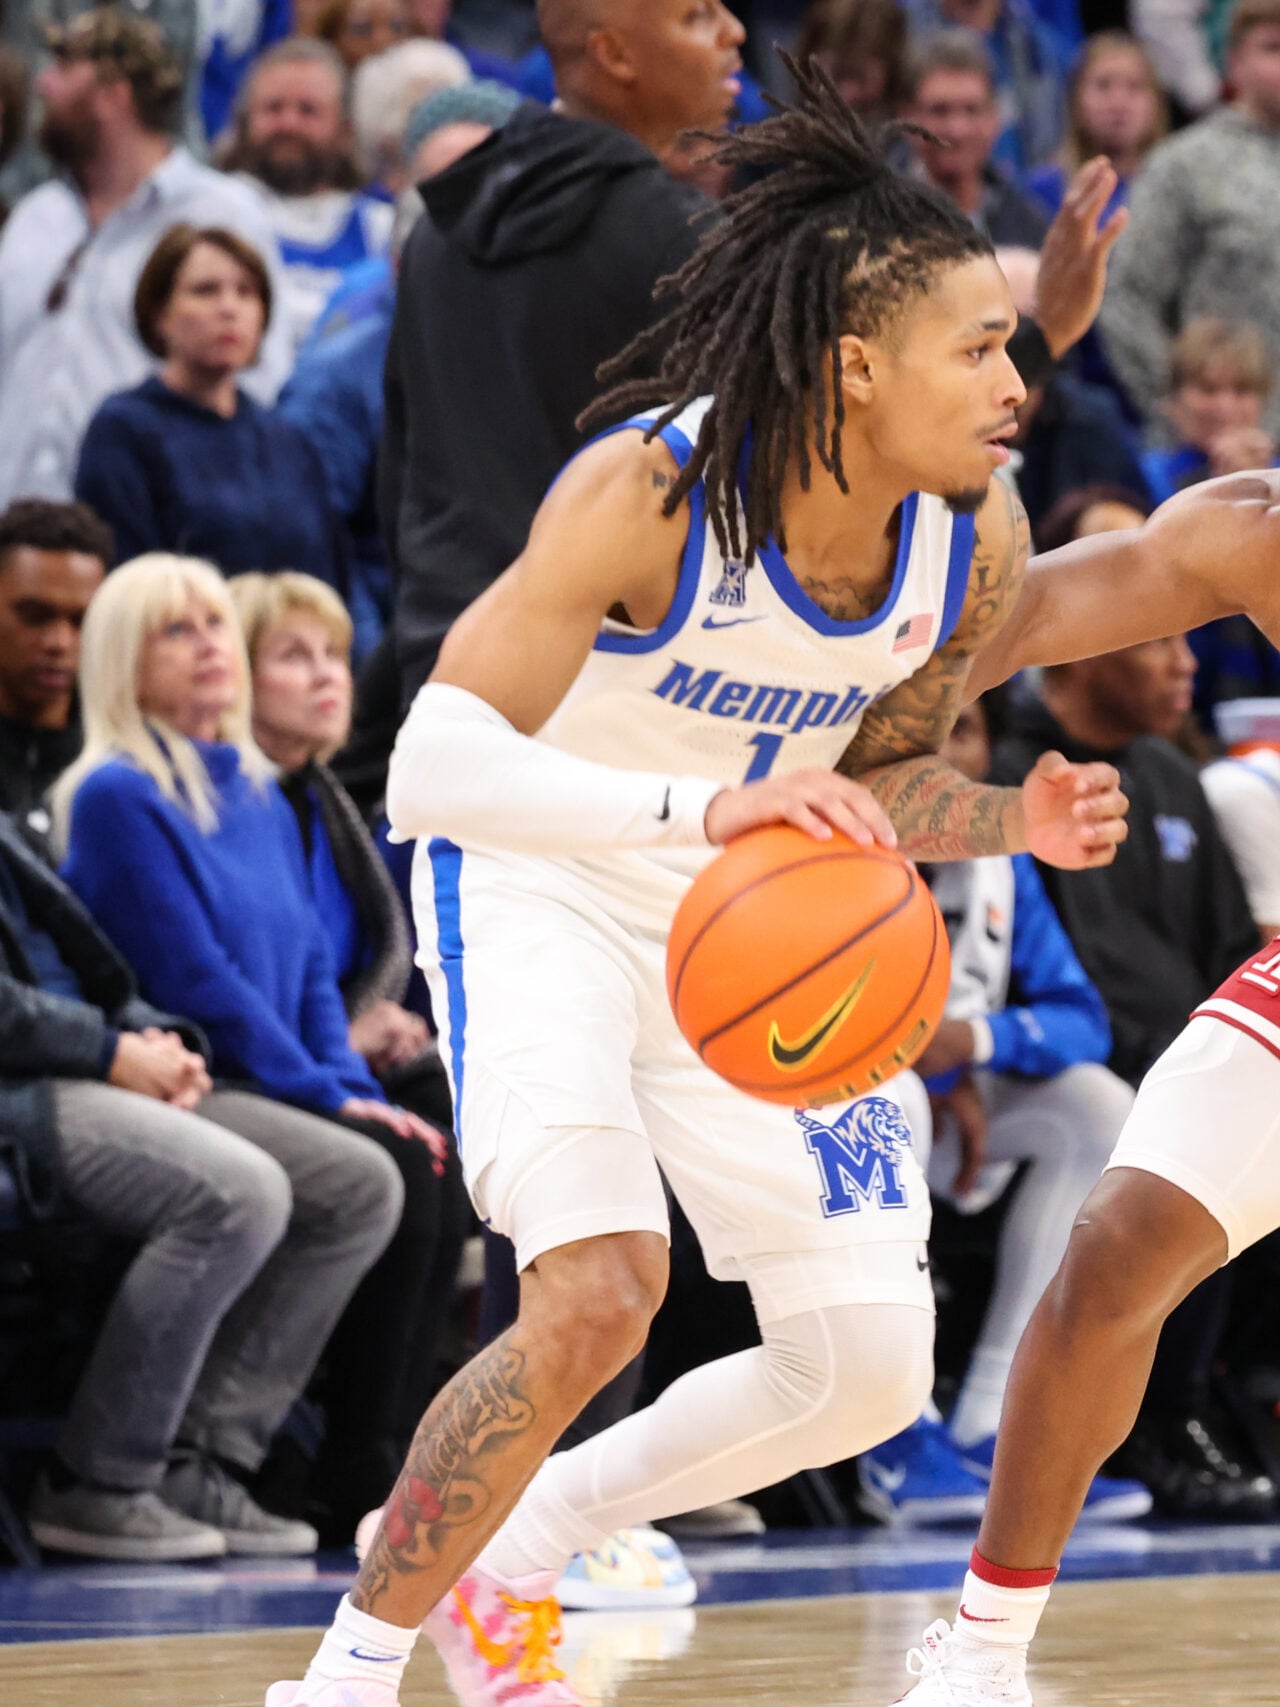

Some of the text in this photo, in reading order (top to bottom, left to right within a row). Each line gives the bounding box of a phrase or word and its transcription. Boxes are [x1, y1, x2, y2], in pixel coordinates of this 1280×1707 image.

[651, 658, 891, 734] Memph
[743, 731, 785, 786] 1
[803, 1123, 909, 1219] M
